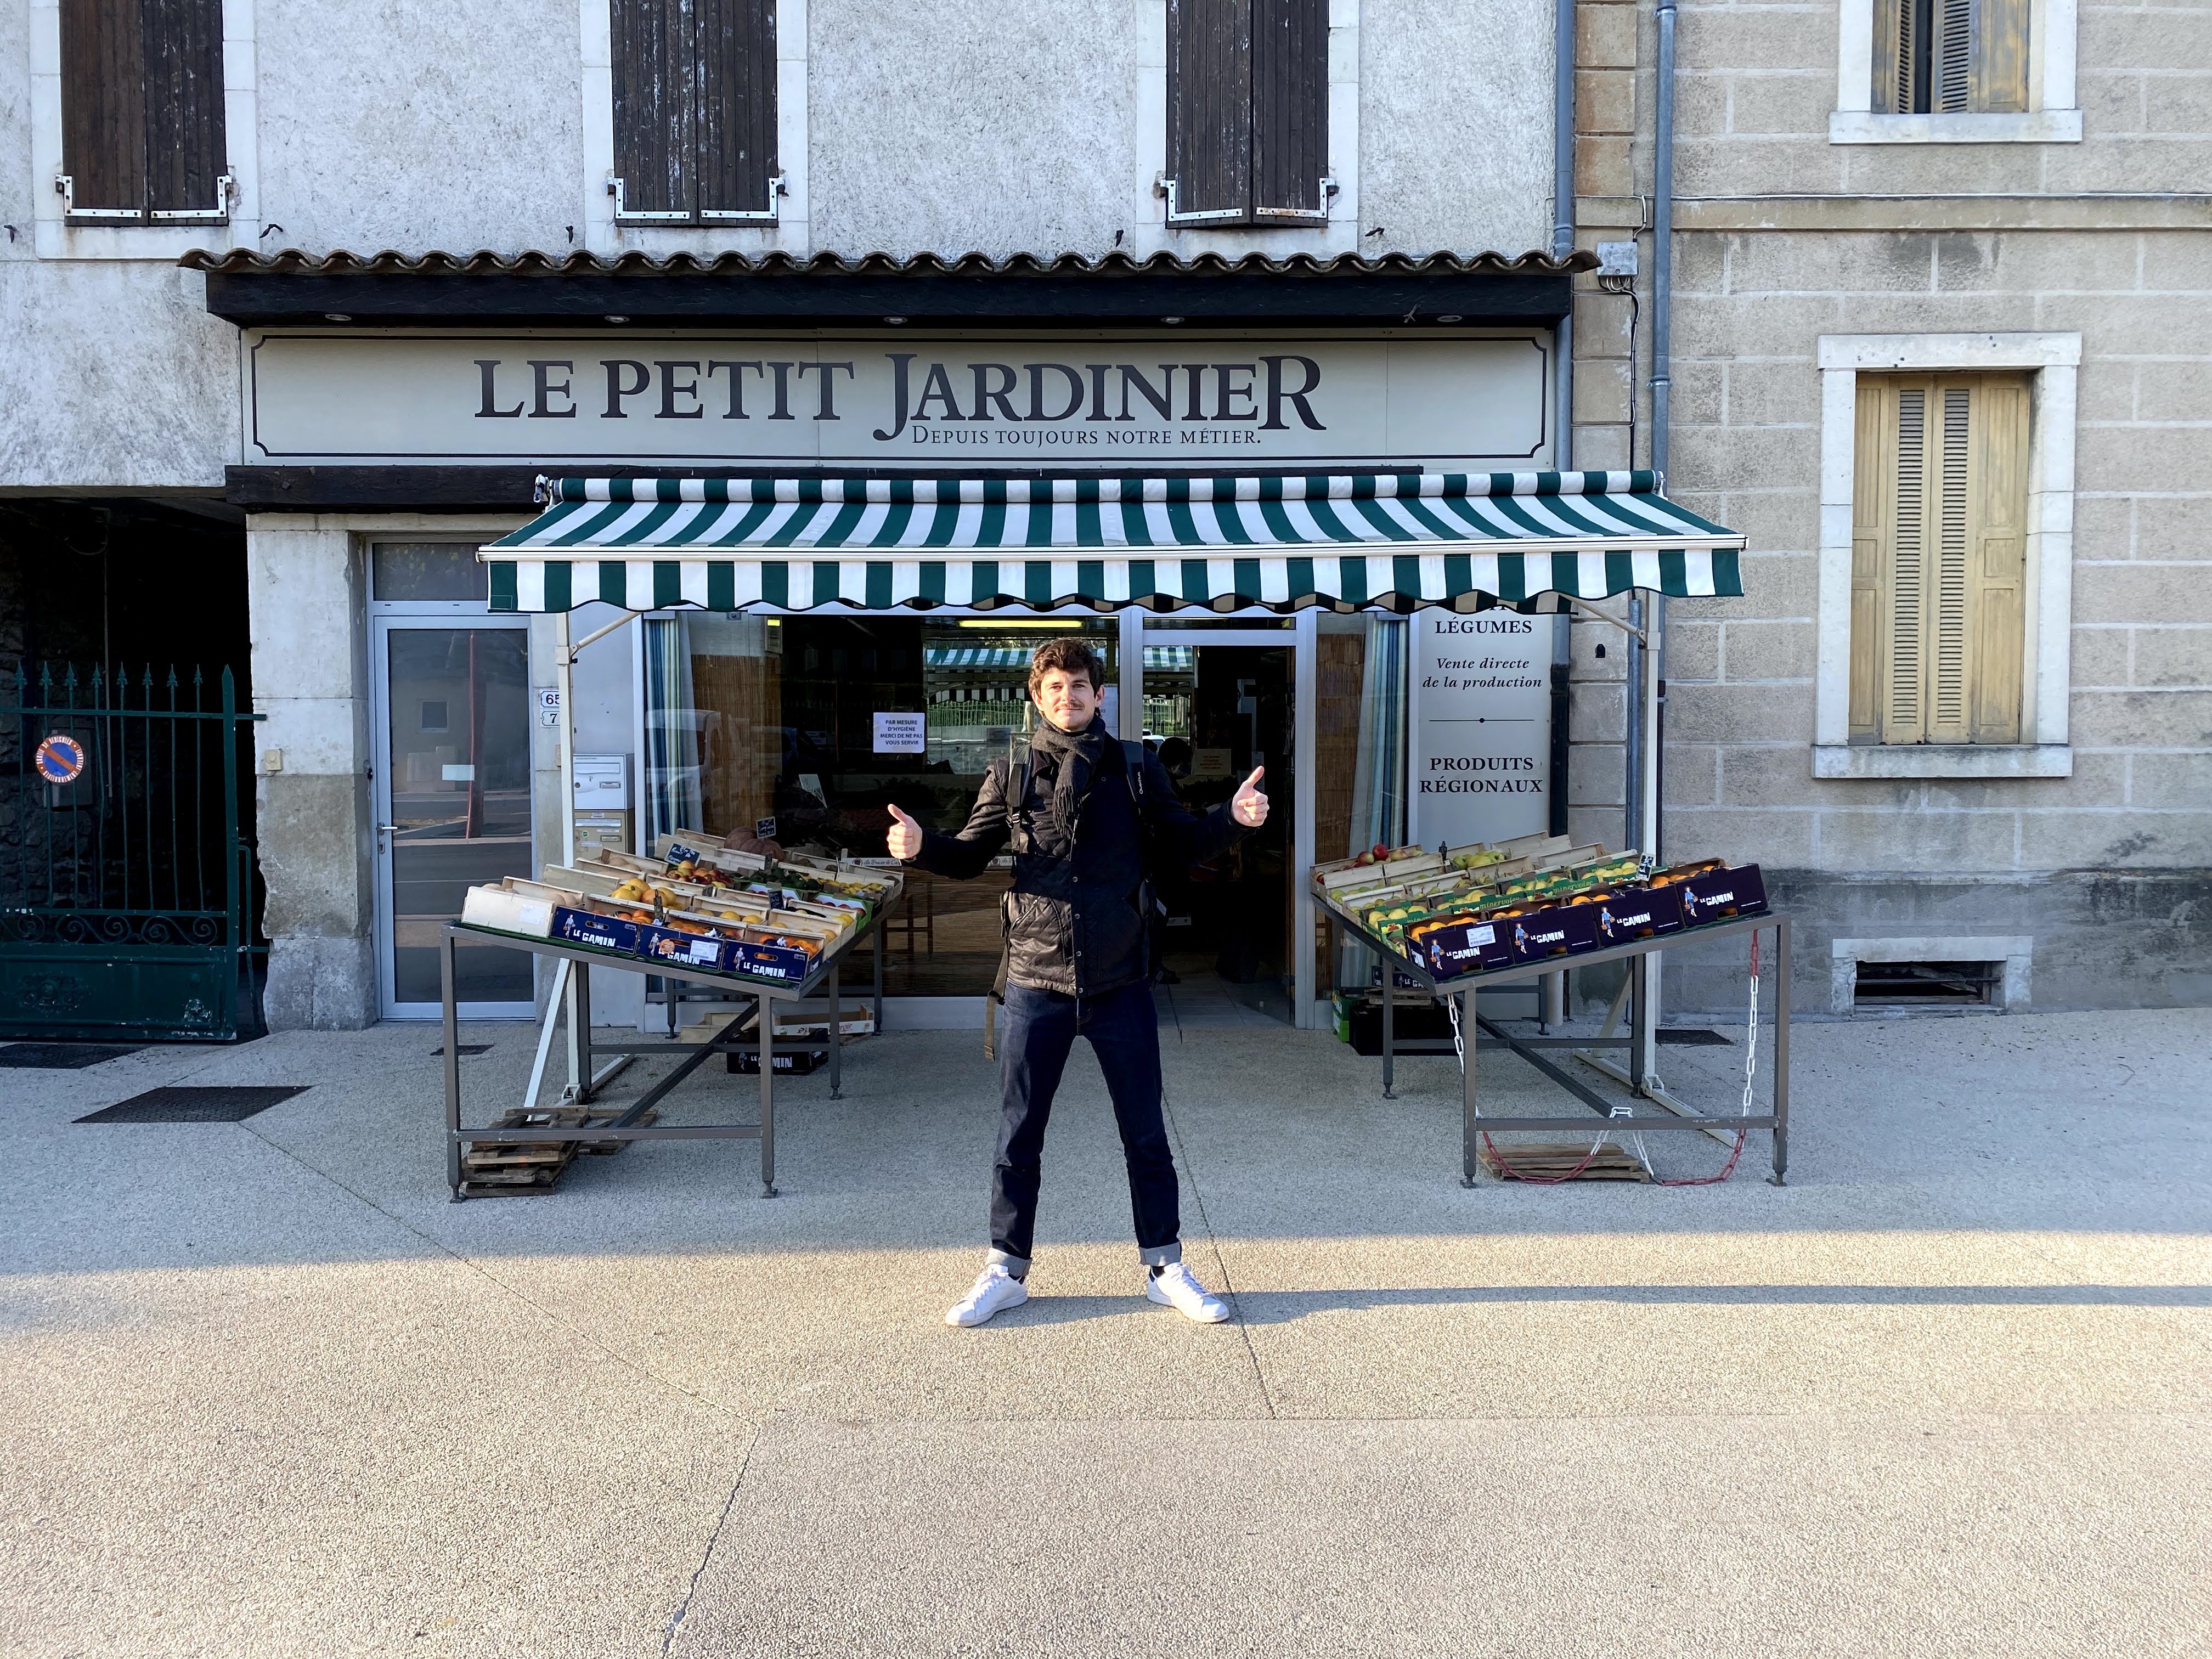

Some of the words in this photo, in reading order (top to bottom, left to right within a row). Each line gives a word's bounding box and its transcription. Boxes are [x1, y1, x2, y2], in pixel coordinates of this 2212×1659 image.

[474, 360, 577, 419] LE
[599, 359, 855, 421] PETIT
[872, 353, 1327, 442] JARDINIER
[912, 425, 989, 444] DEPUIS
[995, 430, 1098, 448] TOUJOURS
[1106, 430, 1172, 444] NOTRE
[1180, 427, 1262, 444] MÉTIER.
[1435, 617, 1533, 634] LÉGUMES
[1436, 657, 1475, 669] Vente
[1479, 657, 1530, 669] directe
[1422, 676, 1439, 688] de
[1443, 676, 1458, 688] la
[1462, 676, 1542, 690] production
[550, 713, 557, 724] 7
[1429, 757, 1534, 771] PRODUITS
[1419, 776, 1543, 793] RÉGIONAUX
[1706, 891, 1734, 906] GAMIN
[1623, 912, 1651, 927] GAMIN
[573, 929, 580, 937] LE
[582, 932, 616, 947] GAMIN
[1537, 930, 1565, 943] GAMIN
[1452, 946, 1480, 960] GAMIN
[752, 964, 786, 978] GAMIN
